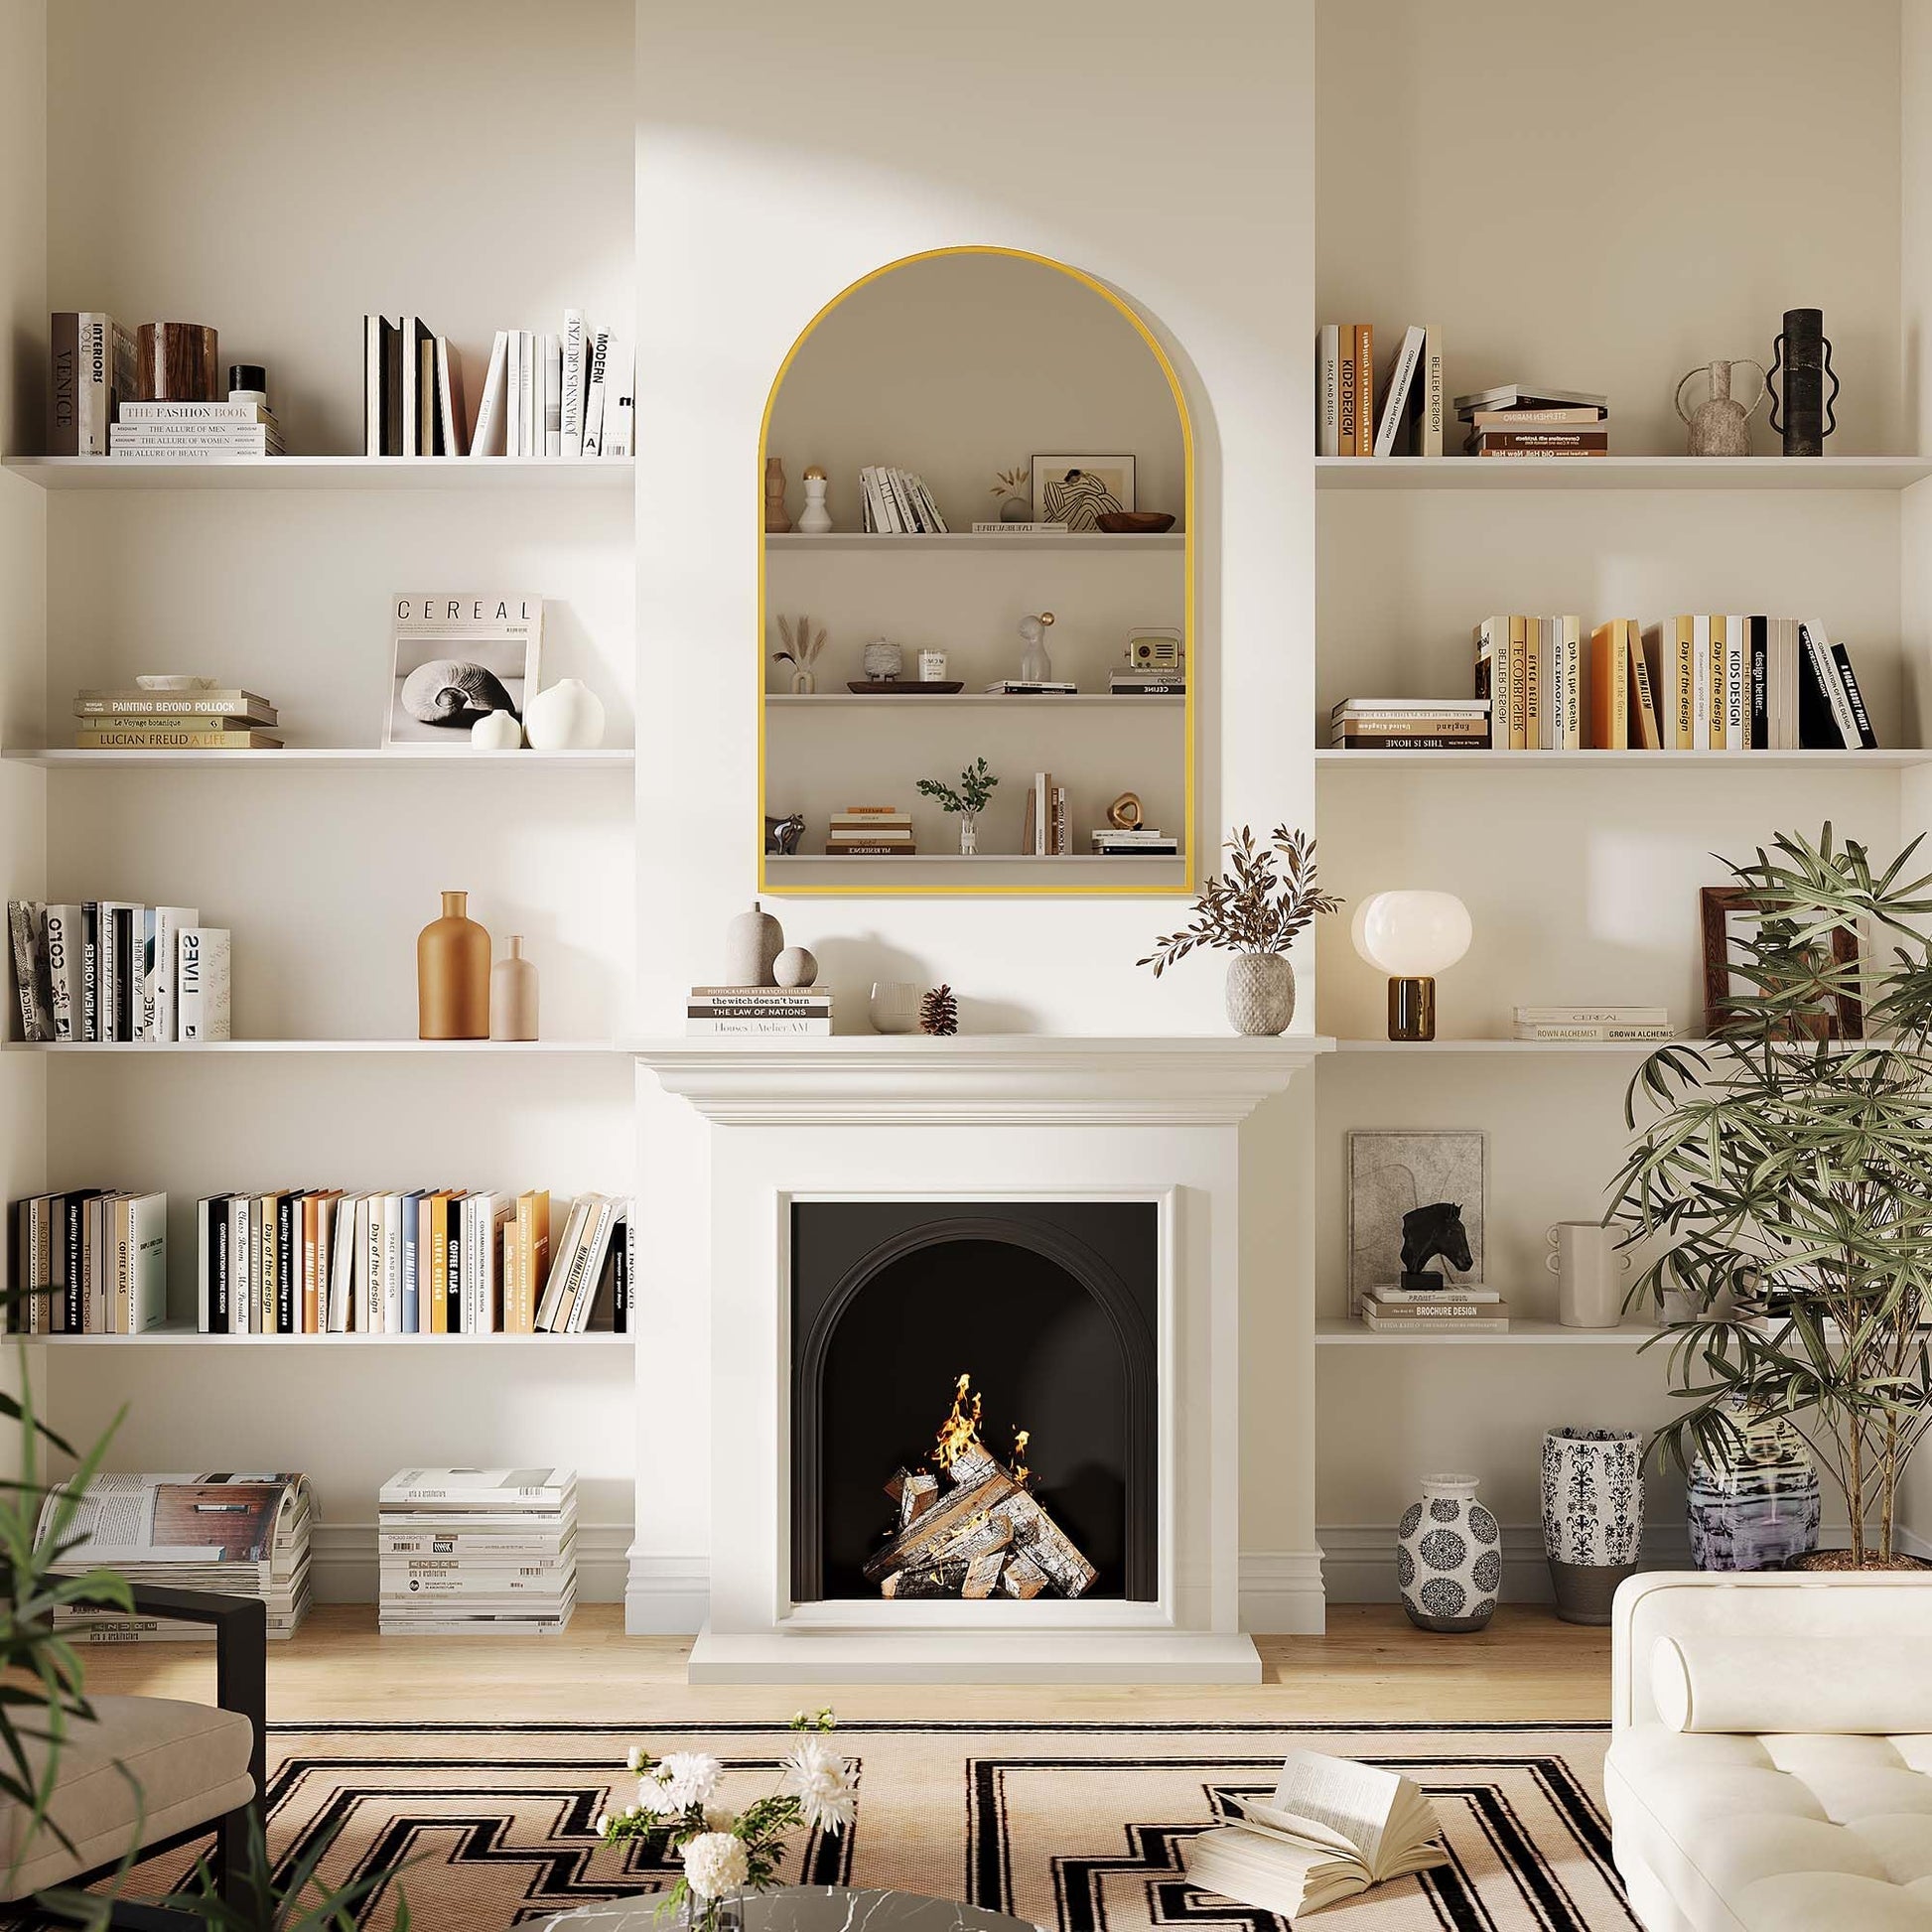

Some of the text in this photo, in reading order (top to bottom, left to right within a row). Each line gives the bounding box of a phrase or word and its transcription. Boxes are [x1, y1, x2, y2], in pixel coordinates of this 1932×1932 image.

[93, 324, 102, 383] INTERIORS
[593, 334, 609, 384] MODERN
[57, 349, 71, 427] VENICE
[565, 374, 579, 436] JOHANNES
[126, 408, 247, 418] THE FASHION BOOK
[397, 600, 530, 620] CEREAL
[1636, 662, 1652, 710] MINIMALISM
[1680, 641, 1690, 732] Day of the design
[1753, 651, 1765, 717] design better...
[1802, 630, 1828, 698] OPEN DESIGN NIGHT
[1818, 641, 1838, 688] CONTAMINATION
[112, 702, 235, 712] PAINTING BEYOND POLLOCK
[1730, 650, 1740, 727] KIDS DESIGN
[1836, 696, 1845, 707] THE
[100, 734, 226, 745] LUCIAN FREUD A LIFE
[124, 719, 148, 728] Voyage
[148, 719, 182, 728] botanique
[1437, 723, 1469, 732] England
[1840, 707, 1852, 730] DESIGN
[715, 1022, 748, 1033] Houses
[757, 1022, 786, 1033] Atelier
[449, 1240, 458, 1294] COFFEE ATLAS
[567, 1245, 588, 1294] MINIMALISM
[69, 1302, 77, 1311] we
[1416, 1307, 1477, 1315] BROCHURE DESIGN
